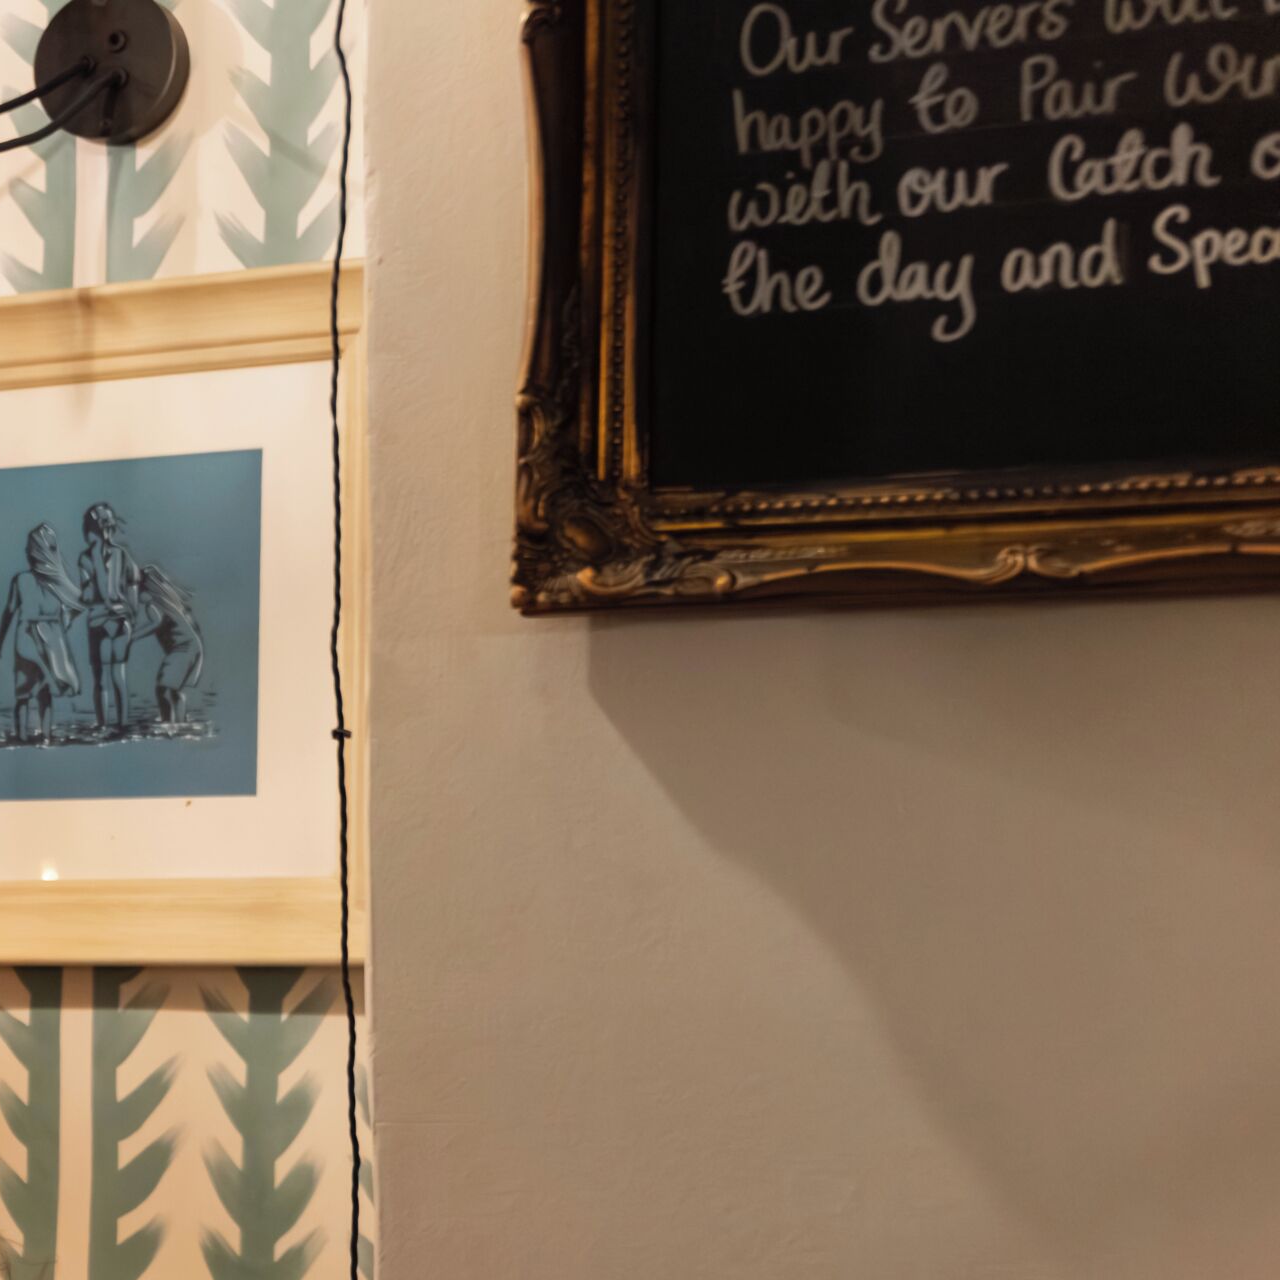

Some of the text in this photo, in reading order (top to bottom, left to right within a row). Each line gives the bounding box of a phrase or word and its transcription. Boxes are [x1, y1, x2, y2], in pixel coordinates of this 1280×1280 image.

[740, 3, 854, 77] Our
[868, 0, 1074, 62] Servers
[733, 88, 884, 169] happy
[909, 62, 979, 134] to
[1019, 53, 1138, 122] Pair
[728, 159, 883, 232] with
[897, 164, 1009, 218] our
[1048, 121, 1222, 201] Catch
[722, 240, 832, 316] the
[856, 230, 976, 343] day
[1000, 217, 1124, 293] and
